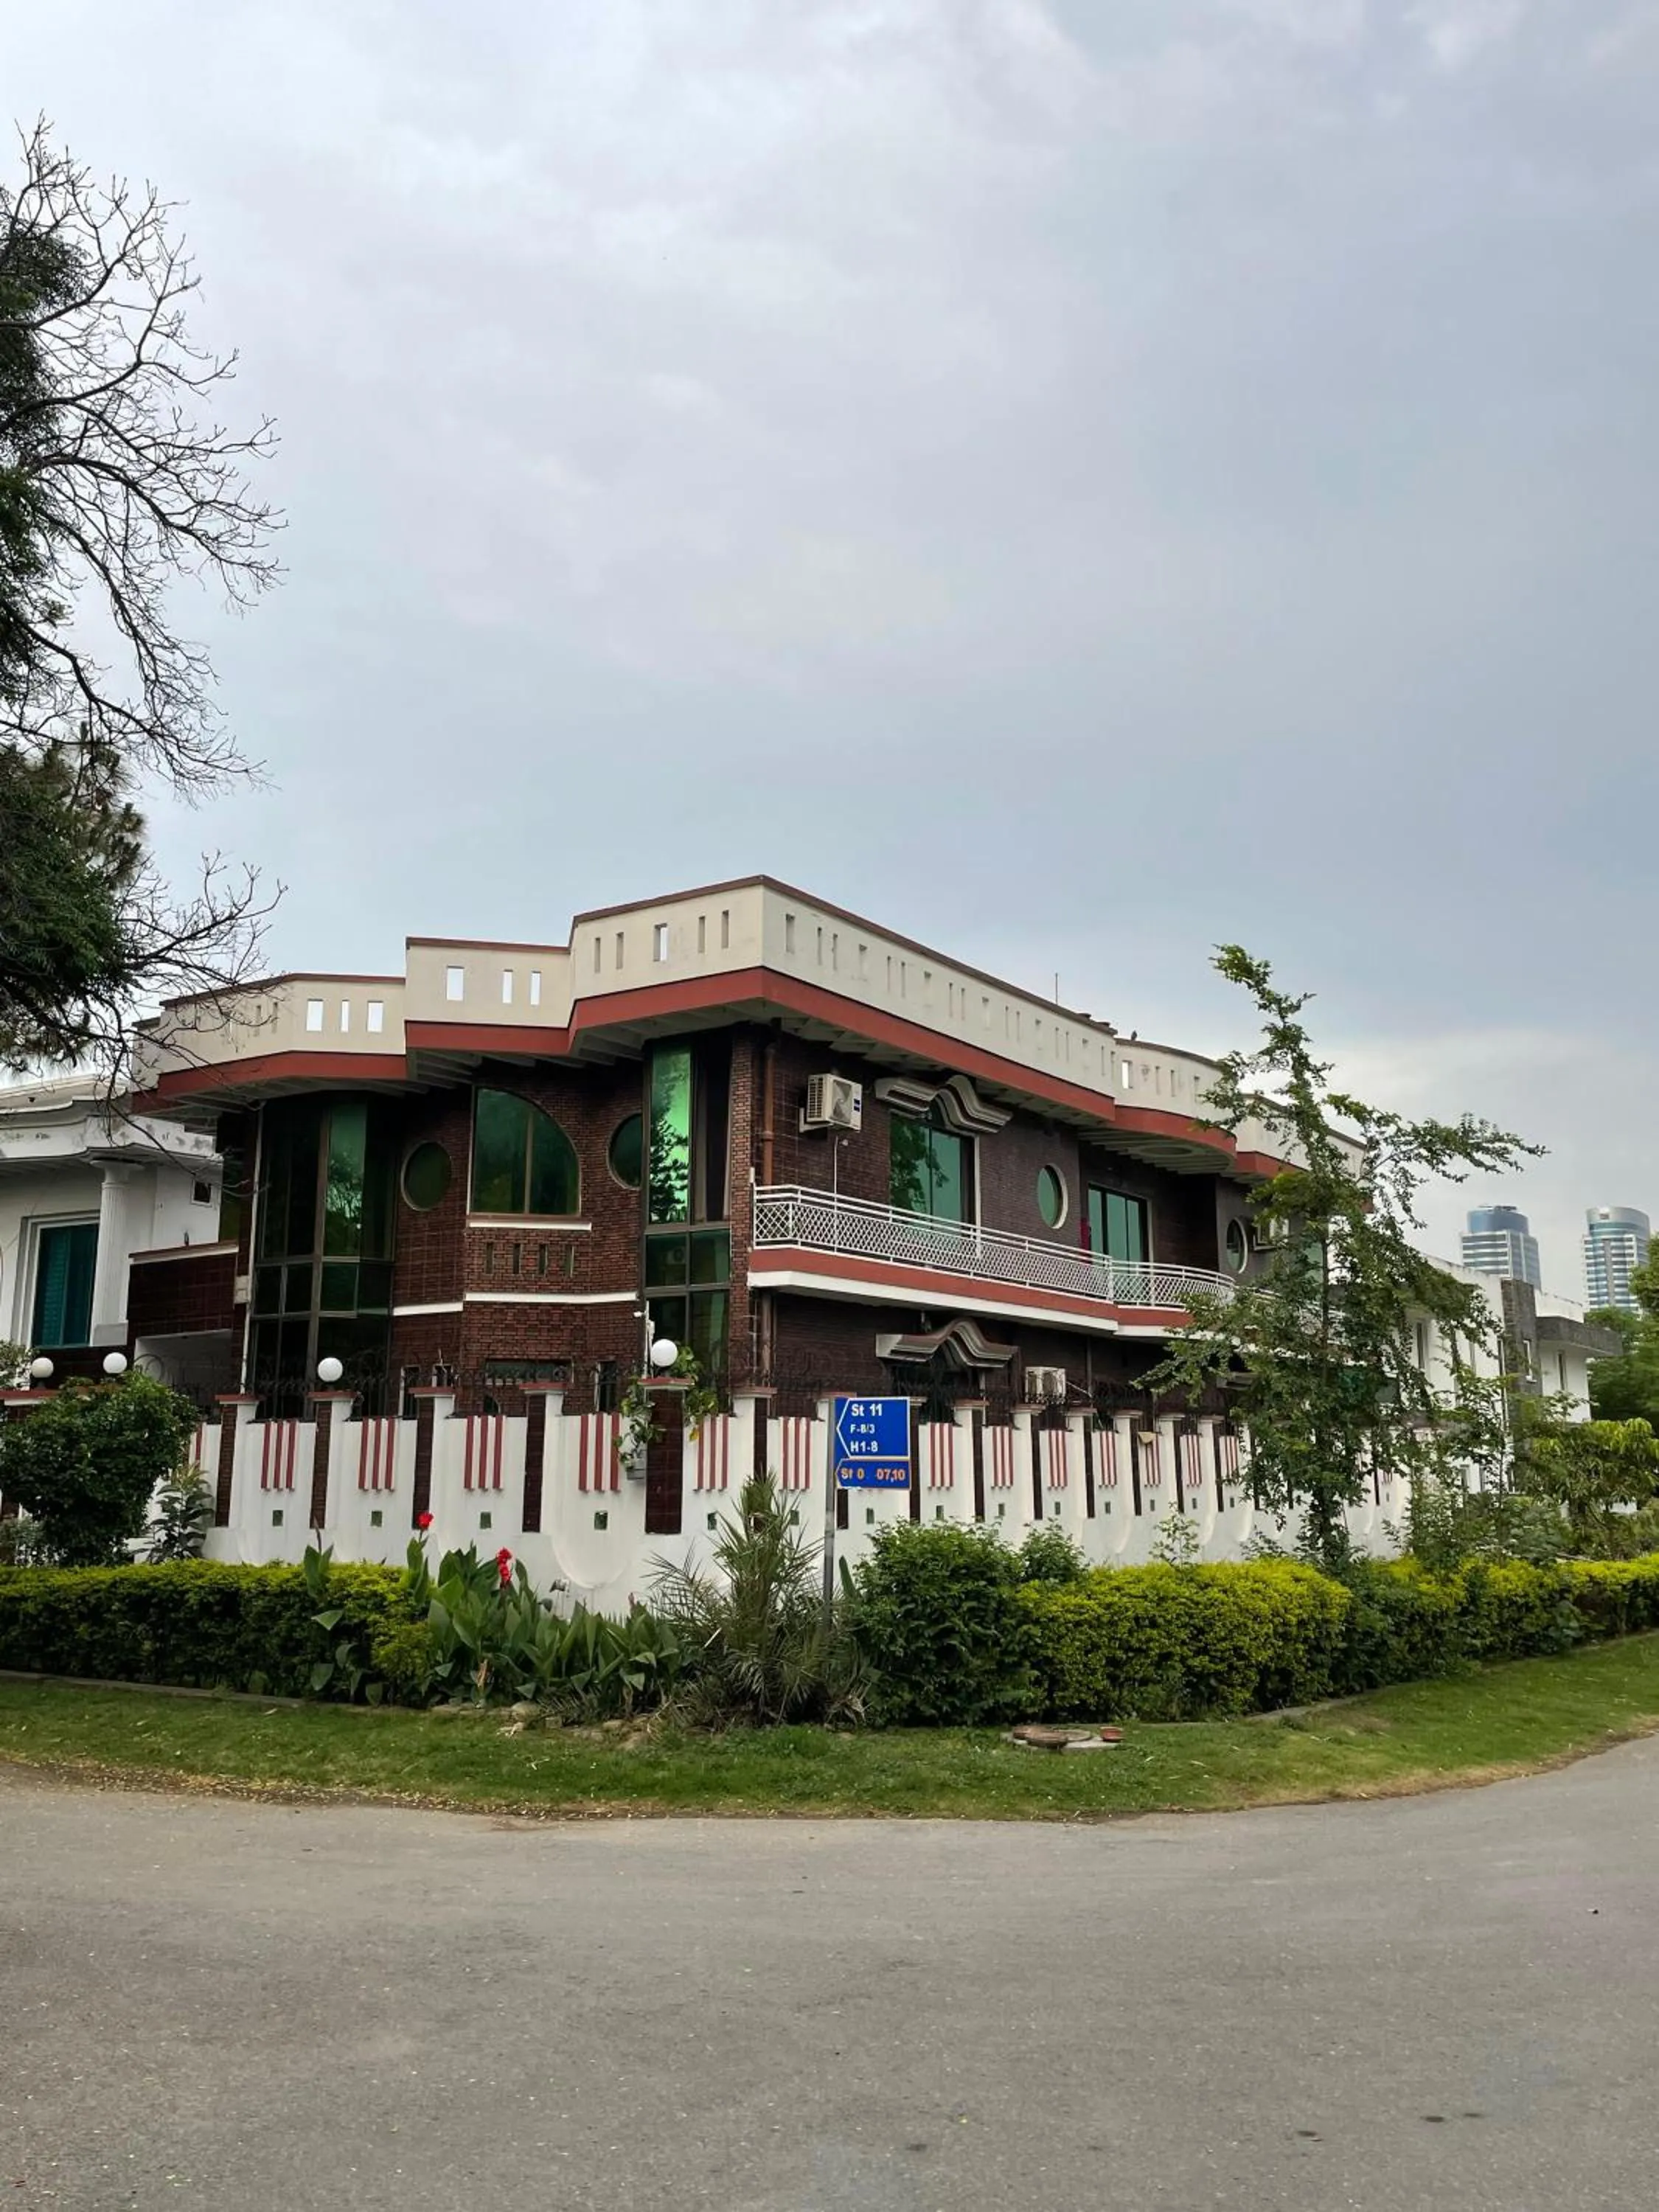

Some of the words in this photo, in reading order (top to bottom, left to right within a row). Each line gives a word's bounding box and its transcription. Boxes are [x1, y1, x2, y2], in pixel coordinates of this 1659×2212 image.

[851, 1403, 865, 1416] St
[869, 1403, 883, 1416] 11
[850, 1440, 878, 1453] H1-8
